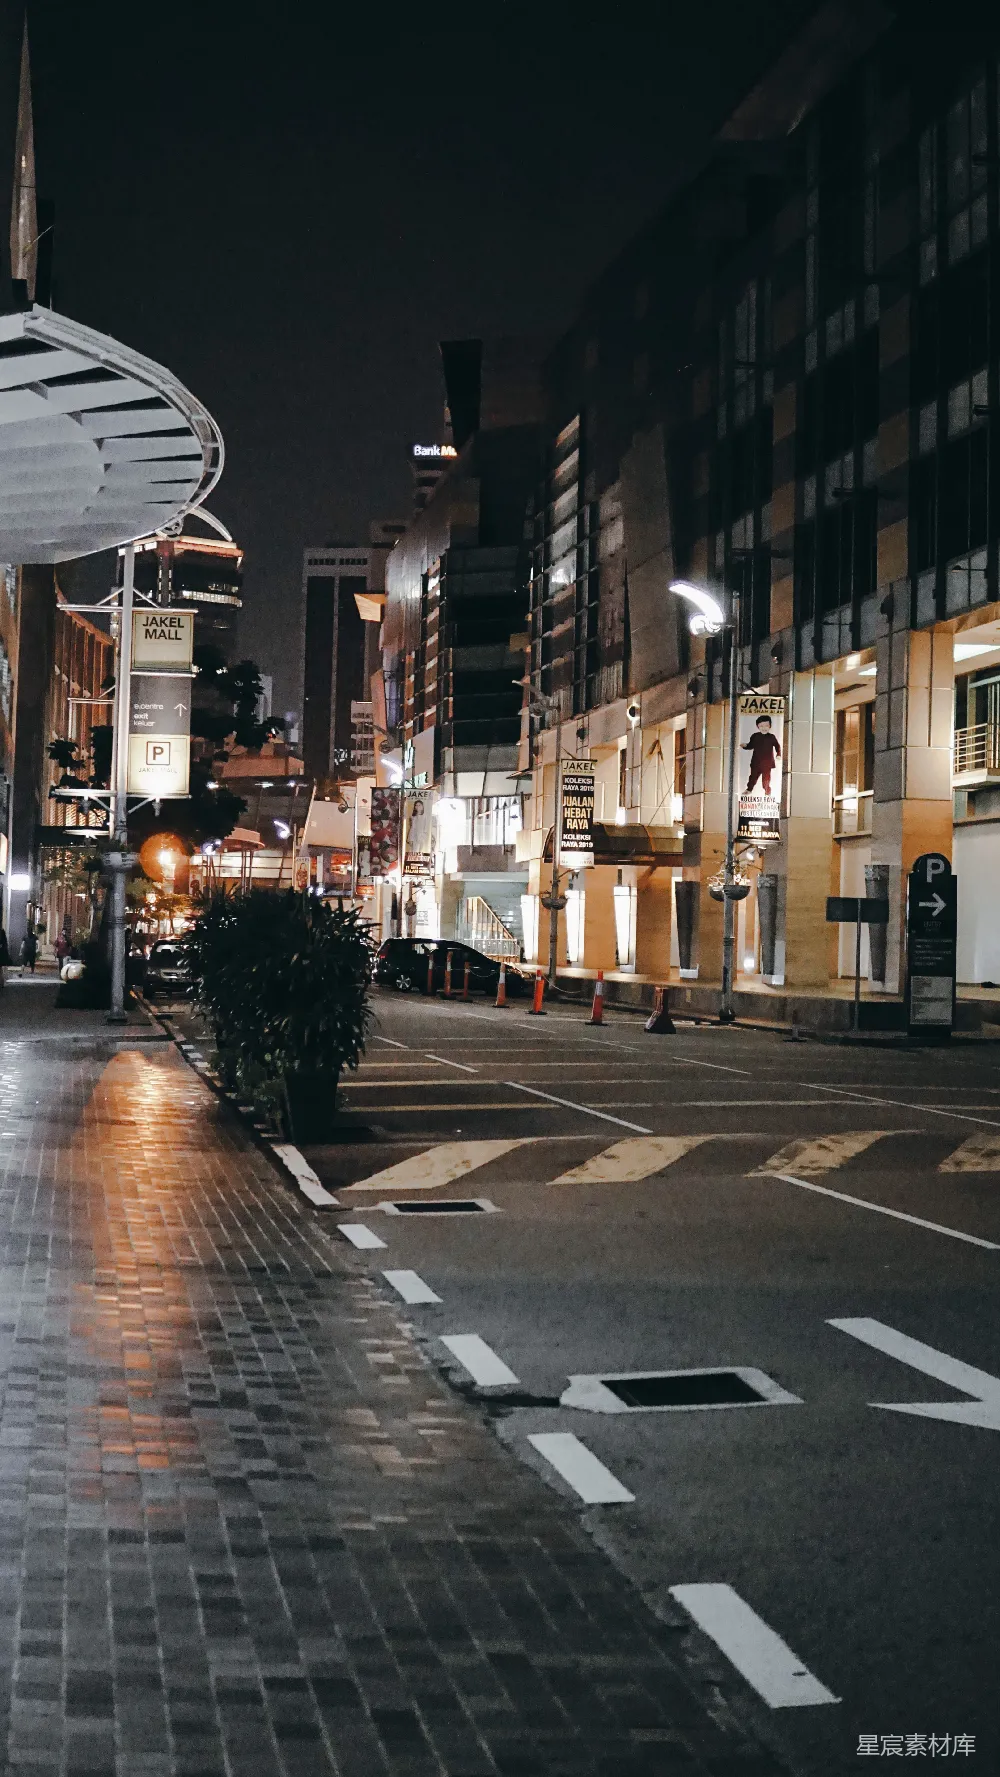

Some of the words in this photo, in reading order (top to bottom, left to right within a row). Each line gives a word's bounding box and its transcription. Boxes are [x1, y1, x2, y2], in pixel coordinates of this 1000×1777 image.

[413, 444, 440, 456] Bank
[142, 616, 184, 628] JAKEL
[145, 628, 182, 640] MALL
[741, 698, 784, 709] JAKEL
[153, 746, 164, 761] P
[563, 761, 595, 771] JAKEL
[562, 796, 594, 807] JUALAN
[564, 807, 592, 819] HEBAT
[566, 819, 589, 830] RAYA
[926, 858, 945, 883] P
